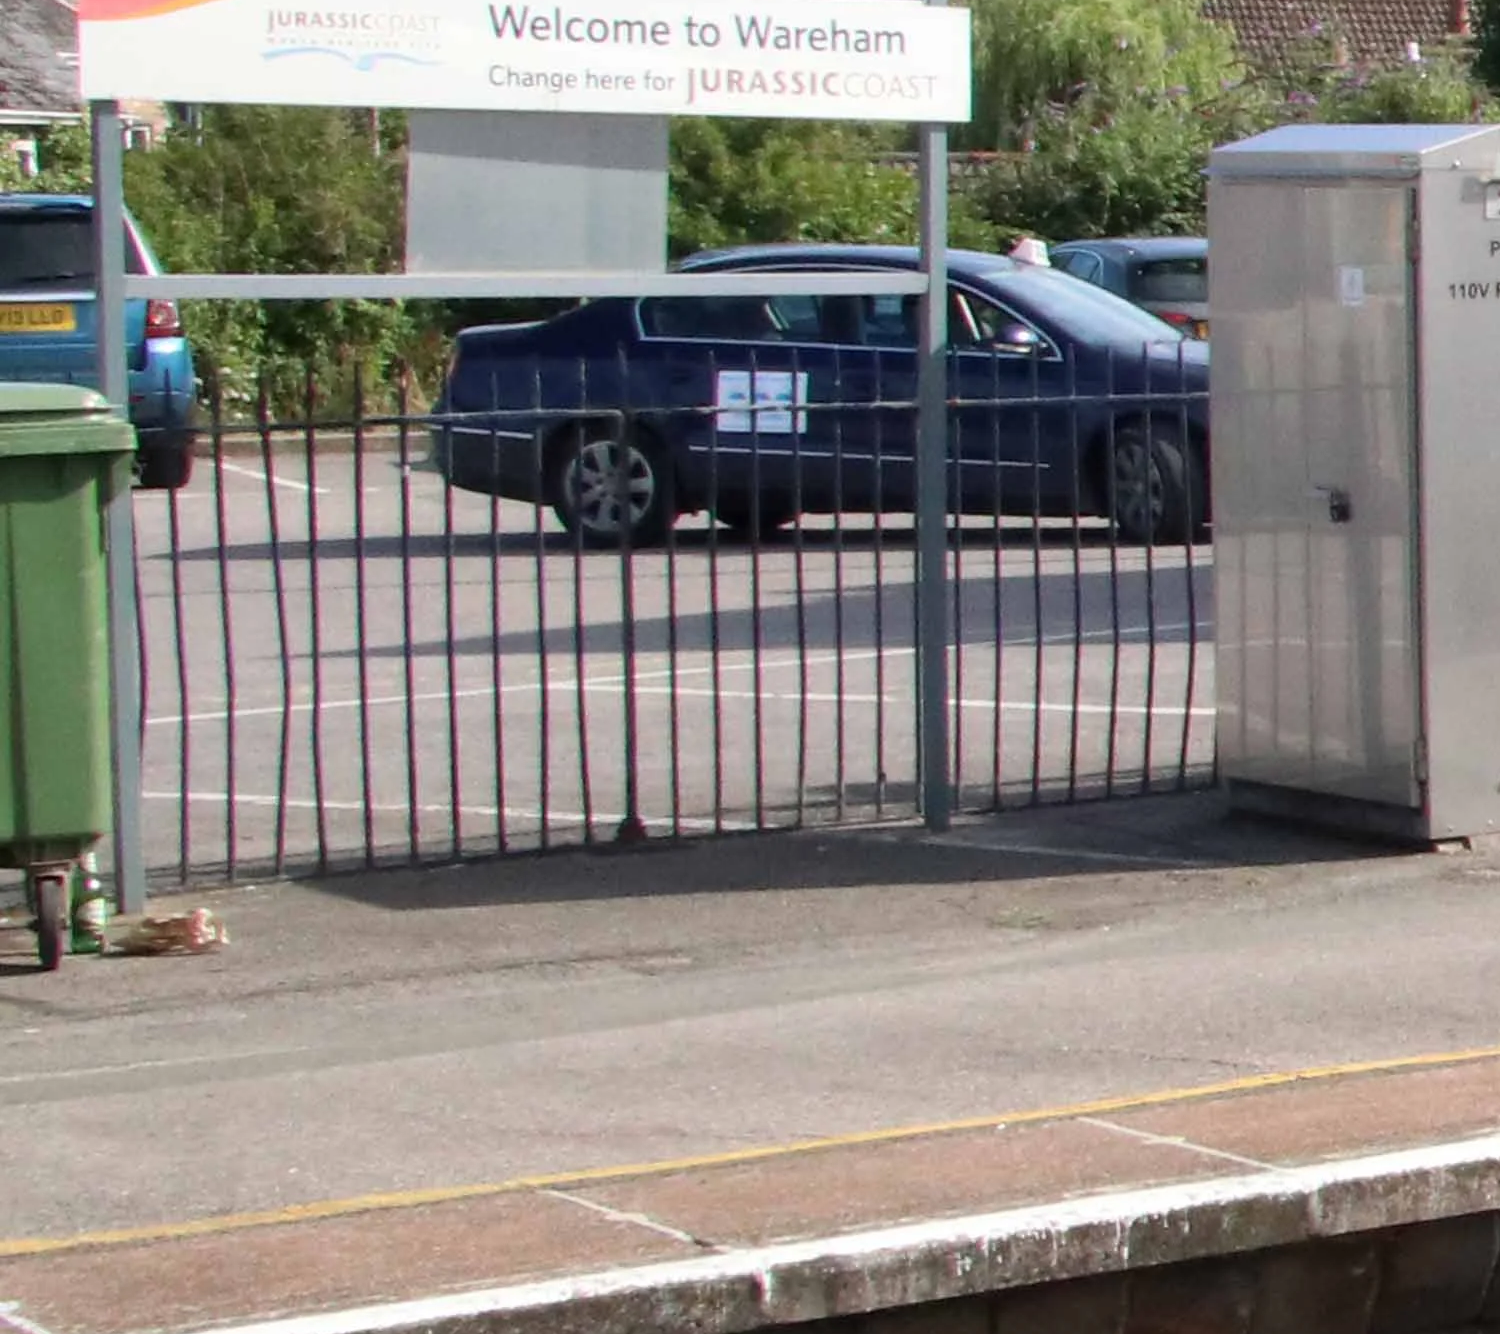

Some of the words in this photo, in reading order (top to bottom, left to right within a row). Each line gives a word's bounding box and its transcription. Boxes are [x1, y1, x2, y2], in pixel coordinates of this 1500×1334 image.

[488, 4, 671, 46] Welcome
[684, 16, 721, 48] to
[733, 13, 906, 54] Wareham
[488, 65, 578, 93] Change
[585, 67, 636, 91] here
[643, 68, 676, 92] for
[1448, 282, 1490, 299] 110V
